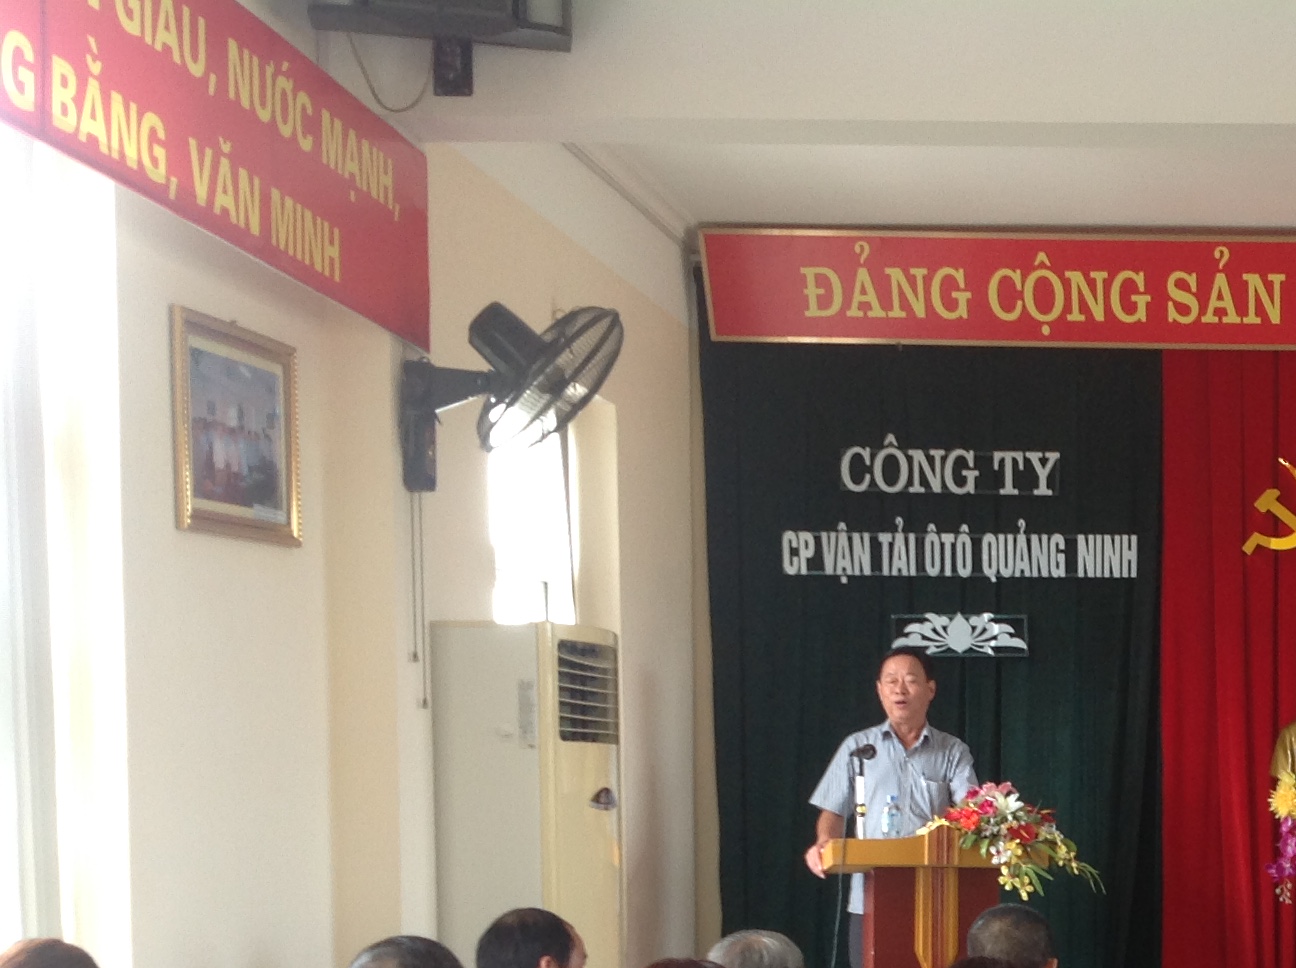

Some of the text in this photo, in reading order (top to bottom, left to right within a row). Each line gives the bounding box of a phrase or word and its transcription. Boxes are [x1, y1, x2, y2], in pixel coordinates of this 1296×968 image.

[52, 34, 178, 200] BẰNG,
[189, 136, 261, 236] VĂN
[270, 187, 341, 283] MINH
[227, 37, 313, 152] NƯỚC
[321, 108, 401, 222] MẠNH,
[801, 241, 972, 320] ĐẢNG
[988, 252, 1152, 336] CỘNG
[1167, 246, 1285, 325] SẢN
[841, 434, 1060, 495] CÔNG TY
[782, 531, 815, 575] CP
[820, 522, 871, 583] VẬN
[878, 517, 916, 576] TẢI
[982, 519, 1065, 582] QUẢNG
[1077, 534, 1137, 577] NINH
